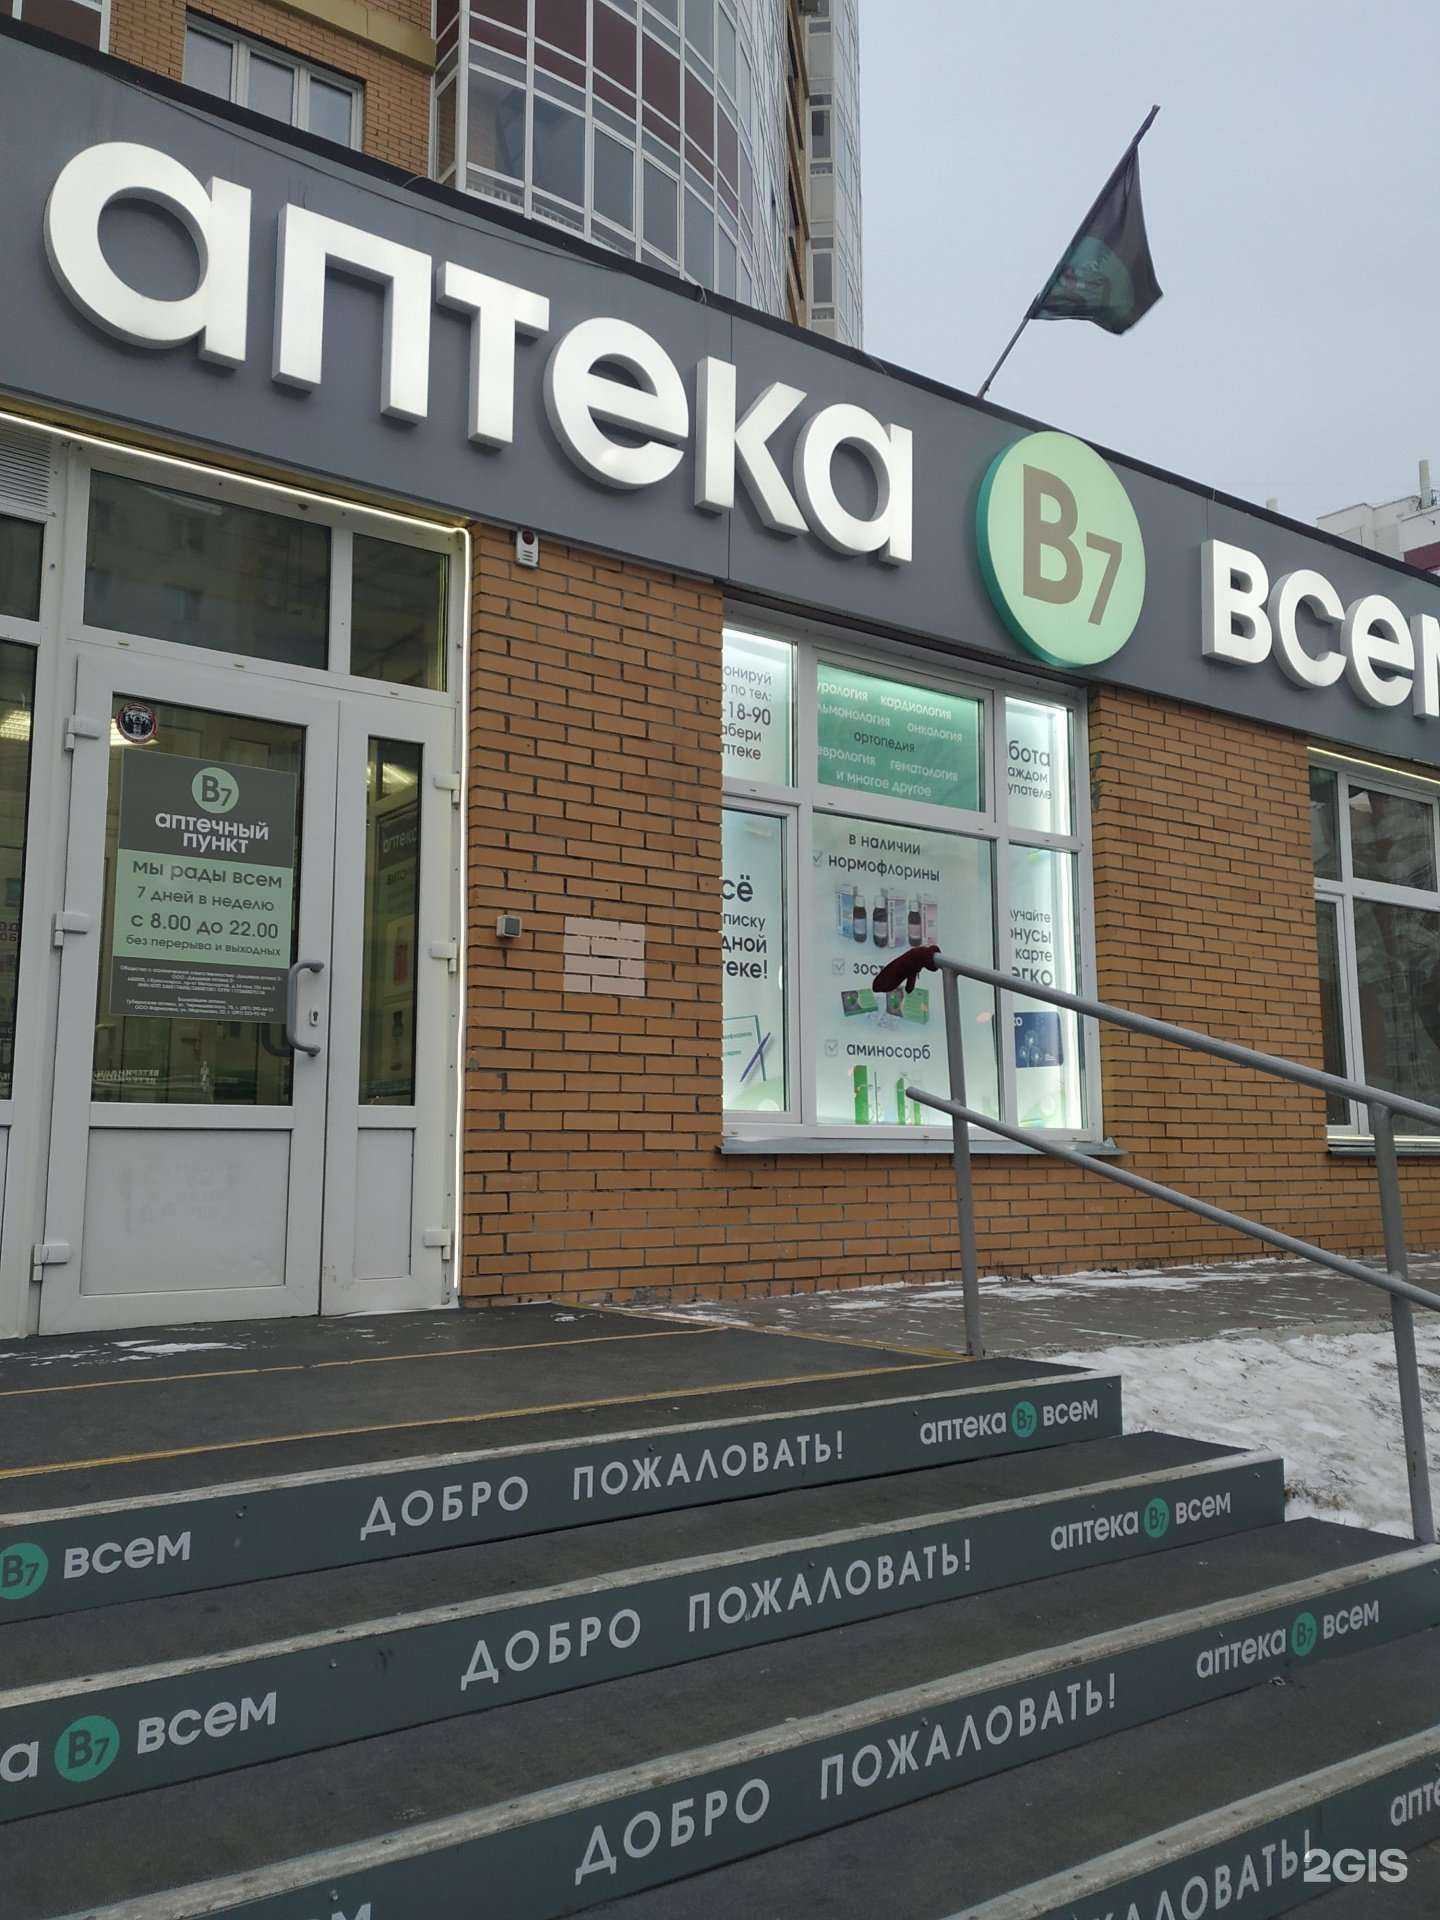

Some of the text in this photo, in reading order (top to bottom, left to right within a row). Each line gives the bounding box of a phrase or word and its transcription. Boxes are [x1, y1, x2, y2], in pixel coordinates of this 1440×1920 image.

[44, 141, 913, 563] аптека
[731, 683, 747, 697] по
[880, 695, 952, 721] кардиология
[854, 731, 915, 753] ортопедия
[907, 722, 963, 743] онкология
[1008, 740, 1051, 767] бота
[889, 760, 959, 782] гематология
[1007, 765, 1048, 783] аждом
[847, 772, 889, 789] многое
[892, 781, 932, 797] другое
[155, 812, 270, 841] аптечный
[183, 832, 249, 854] пункт
[849, 834, 921, 856] в наличии
[132, 861, 283, 888] мы рады всем
[828, 854, 941, 882] нормофлорины
[137, 886, 275, 912] 7 дней в неделю
[131, 912, 279, 939] с 8.00 до 22.00
[723, 913, 766, 932] писку
[126, 934, 281, 957] без перерыва и выходных
[1015, 948, 1053, 963] карте
[722, 959, 768, 980] еке!
[847, 1043, 931, 1063] аминосорб
[920, 1409, 1007, 1446] аптека
[1043, 1398, 1099, 1427] всем
[360, 1430, 845, 1541] ДОБРО ПОЖАЛОВАТЬ!
[1050, 1510, 1139, 1551] аптека
[1175, 1492, 1231, 1525] всем
[63, 1531, 192, 1579] всем
[460, 1538, 971, 1691] ДОБРО ПОЖАЛОВАТЬ!
[1196, 1627, 1287, 1679] аптека
[1322, 1600, 1380, 1641] всем
[137, 1692, 277, 1755] всем
[574, 1672, 1115, 1885] ДОБРО ПОЖАЛОВАТЬ!
[1073, 1829, 1311, 1920] ЛОВАТЬ!
